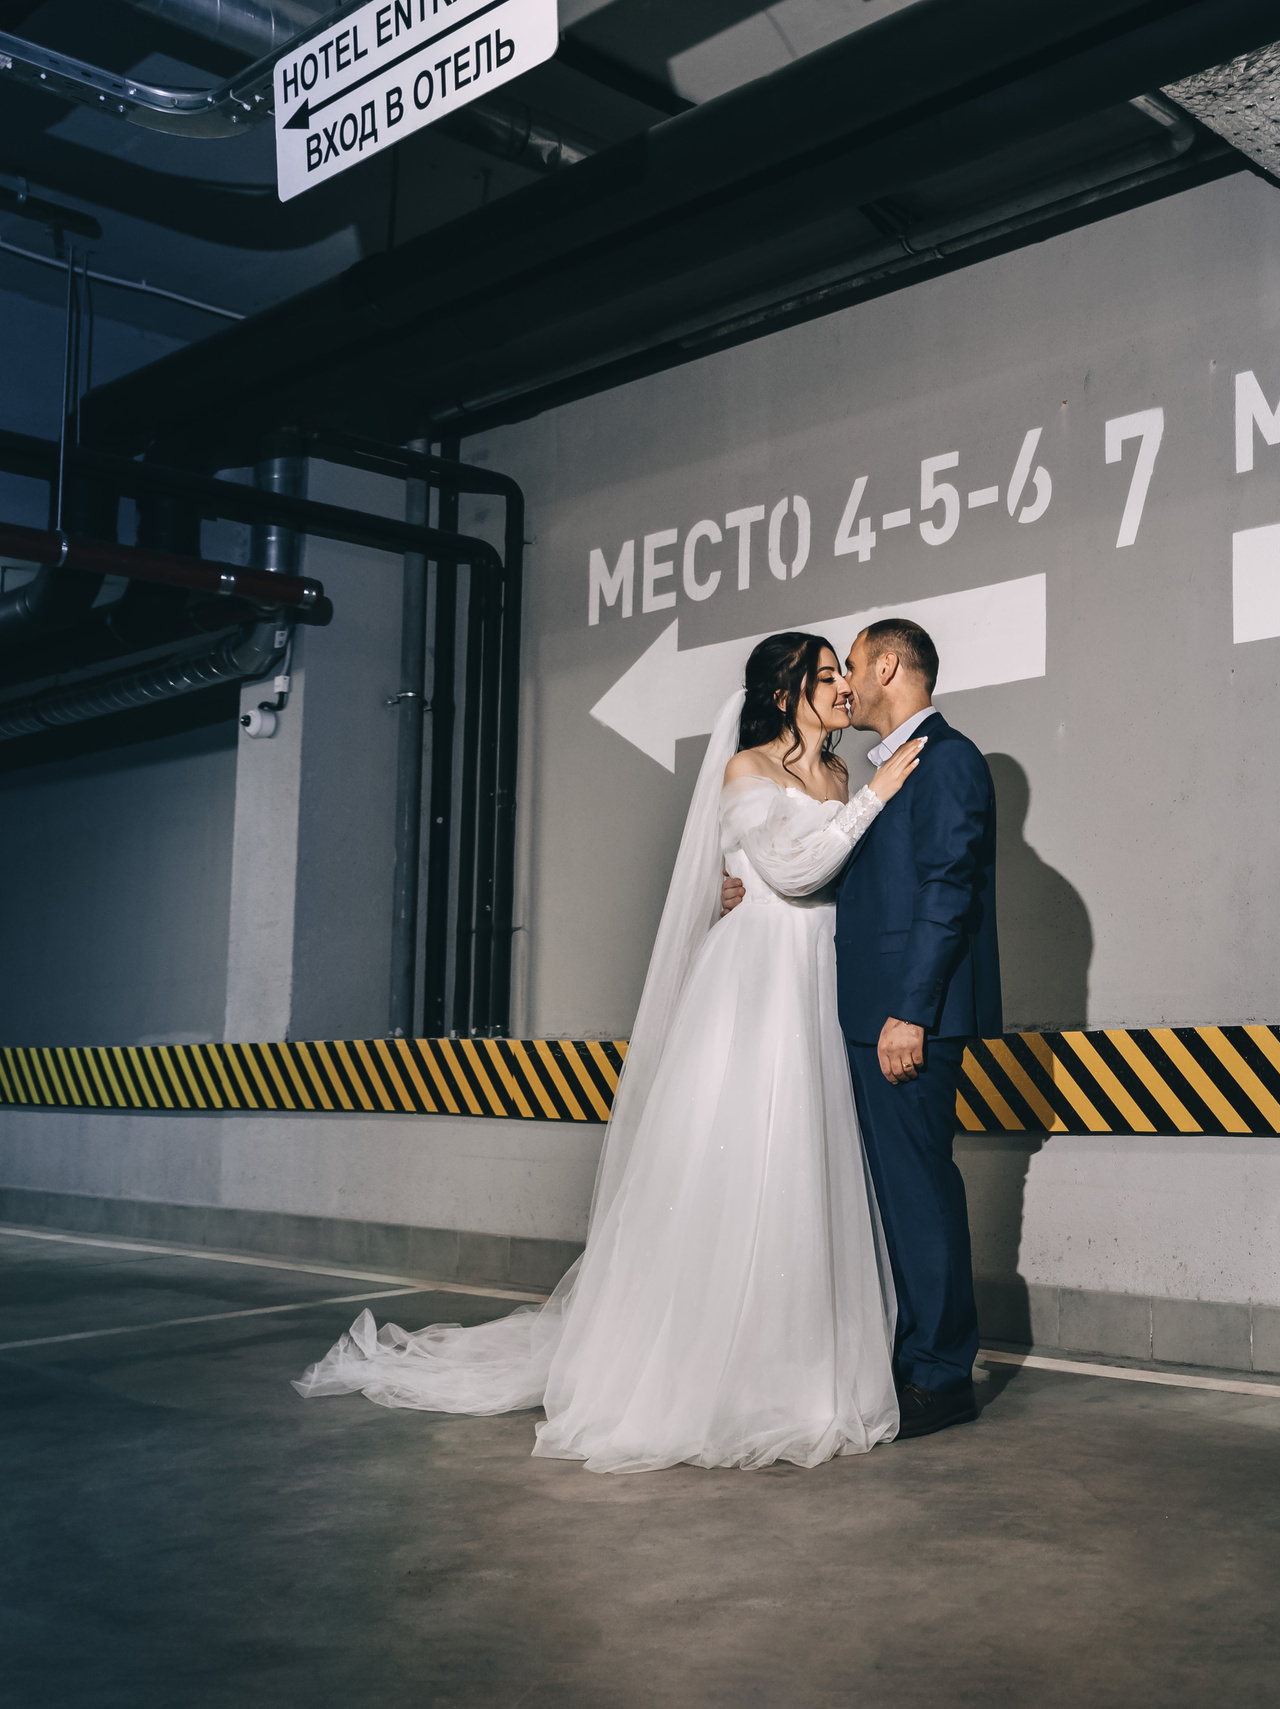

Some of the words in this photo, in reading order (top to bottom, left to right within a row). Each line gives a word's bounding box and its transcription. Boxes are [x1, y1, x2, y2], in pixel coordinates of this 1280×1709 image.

[282, 24, 369, 104] HOTEL
[306, 99, 379, 172] ВХОД
[385, 86, 404, 128] В
[413, 28, 515, 111] ОТЕЛЬ
[588, 495, 811, 626] МЕСТО
[834, 427, 1053, 563] 4-5-6
[1104, 407, 1165, 549] 7
